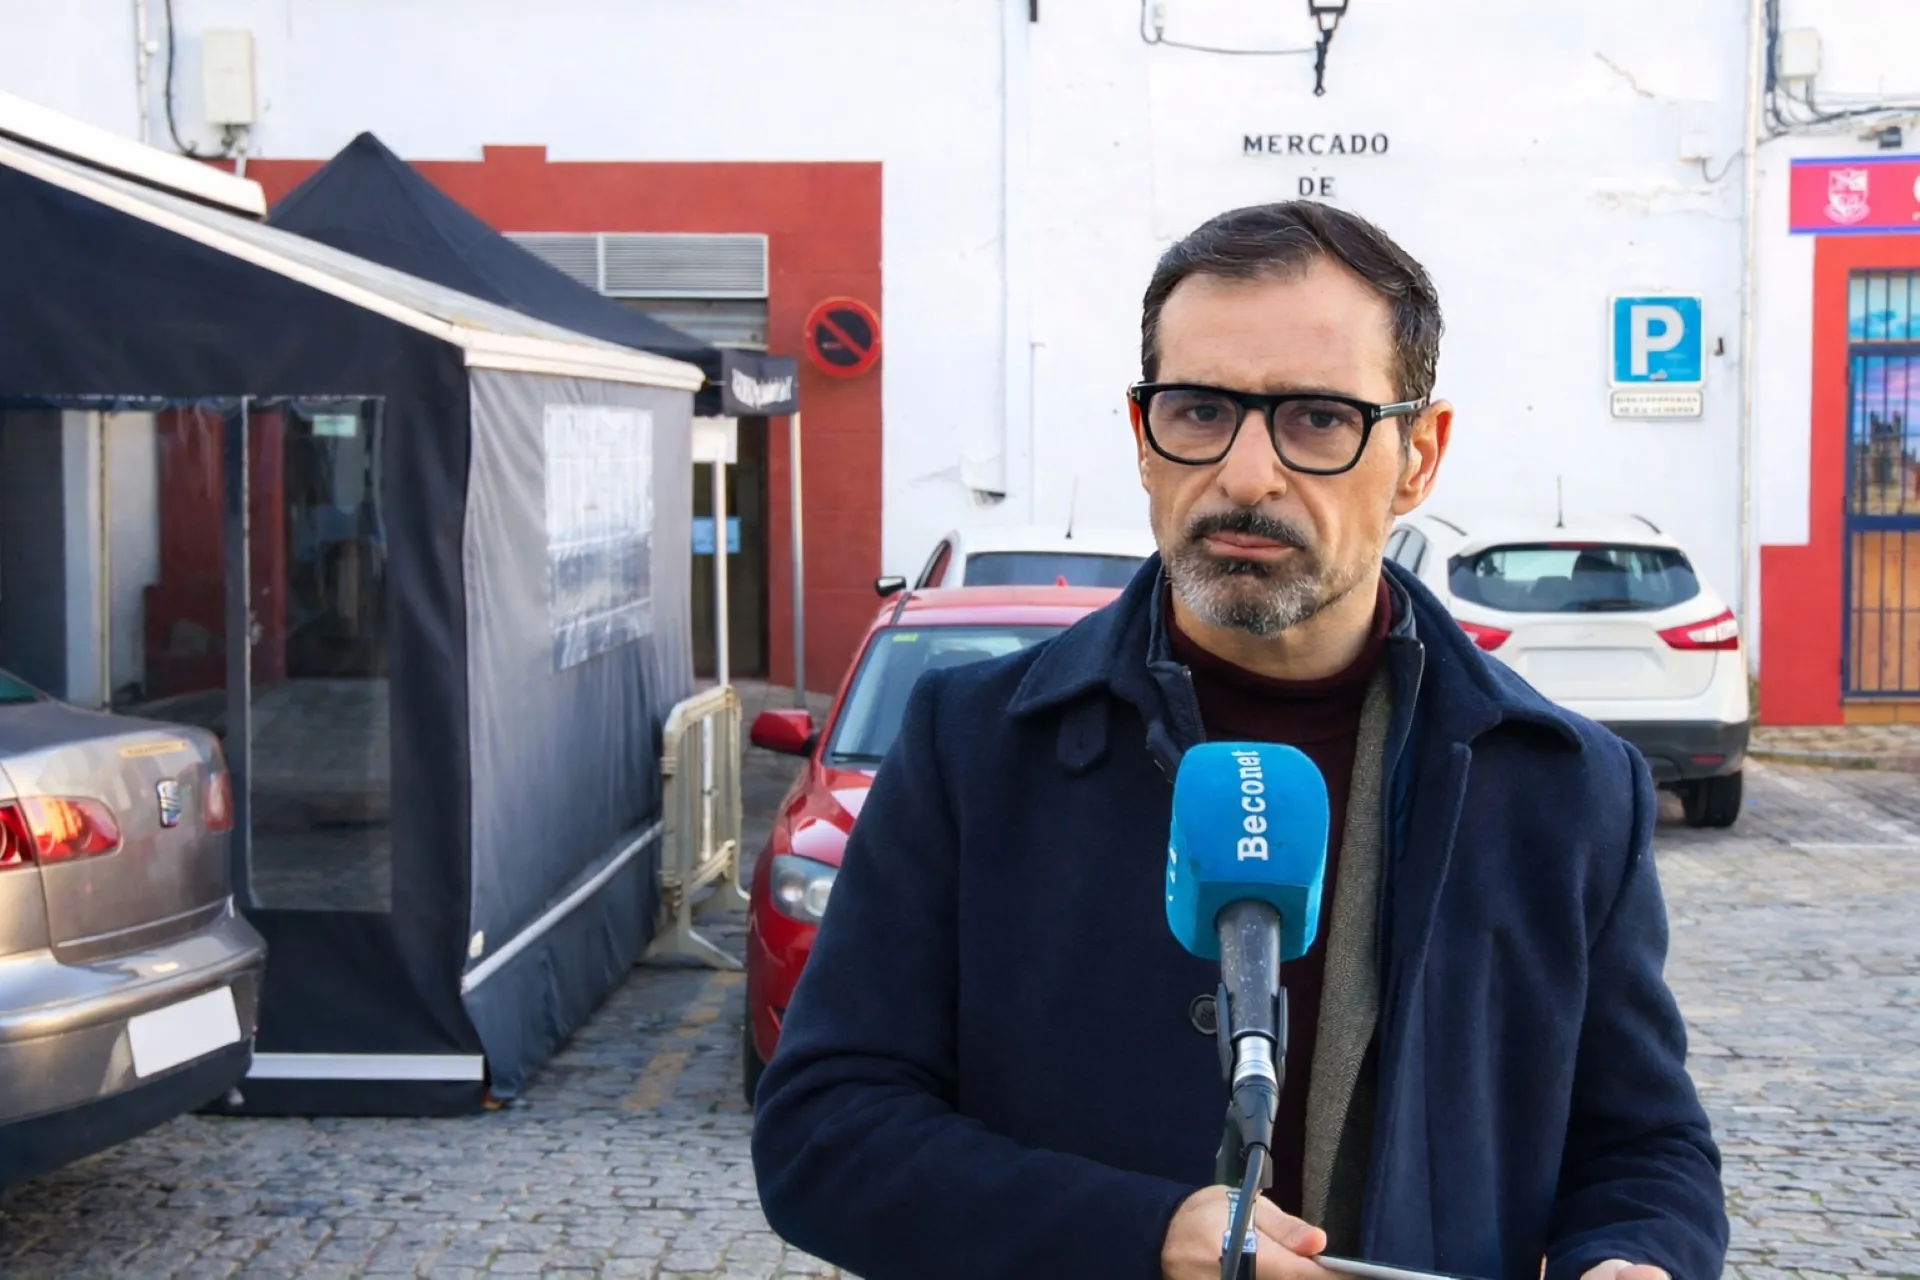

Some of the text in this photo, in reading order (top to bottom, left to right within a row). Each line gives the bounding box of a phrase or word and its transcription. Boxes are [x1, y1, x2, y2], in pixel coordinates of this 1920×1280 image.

[1243, 134, 1389, 154] MERCADO
[1299, 177, 1335, 197] DE
[1630, 305, 1684, 376] P
